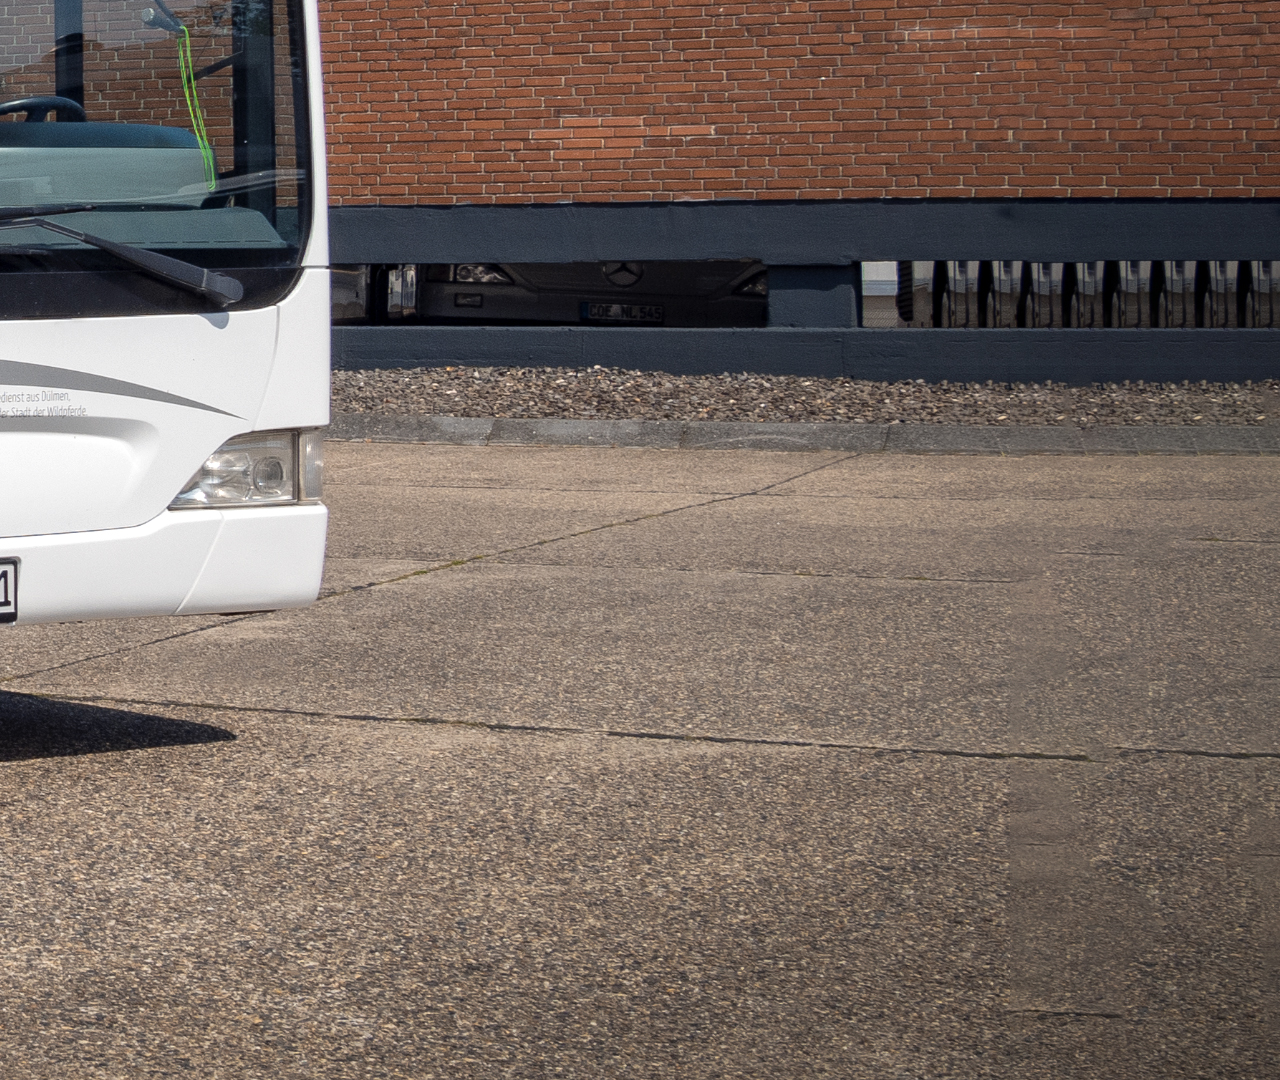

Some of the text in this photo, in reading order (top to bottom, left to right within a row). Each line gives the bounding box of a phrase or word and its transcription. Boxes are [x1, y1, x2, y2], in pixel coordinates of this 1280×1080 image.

[589, 305, 613, 318] COE
[621, 306, 637, 319] NL
[26, 393, 40, 402] aus
[42, 390, 72, 402] Dülmen,
[10, 406, 32, 419] Stadt
[33, 407, 45, 418] der
[47, 405, 89, 419] Wildpferde.
